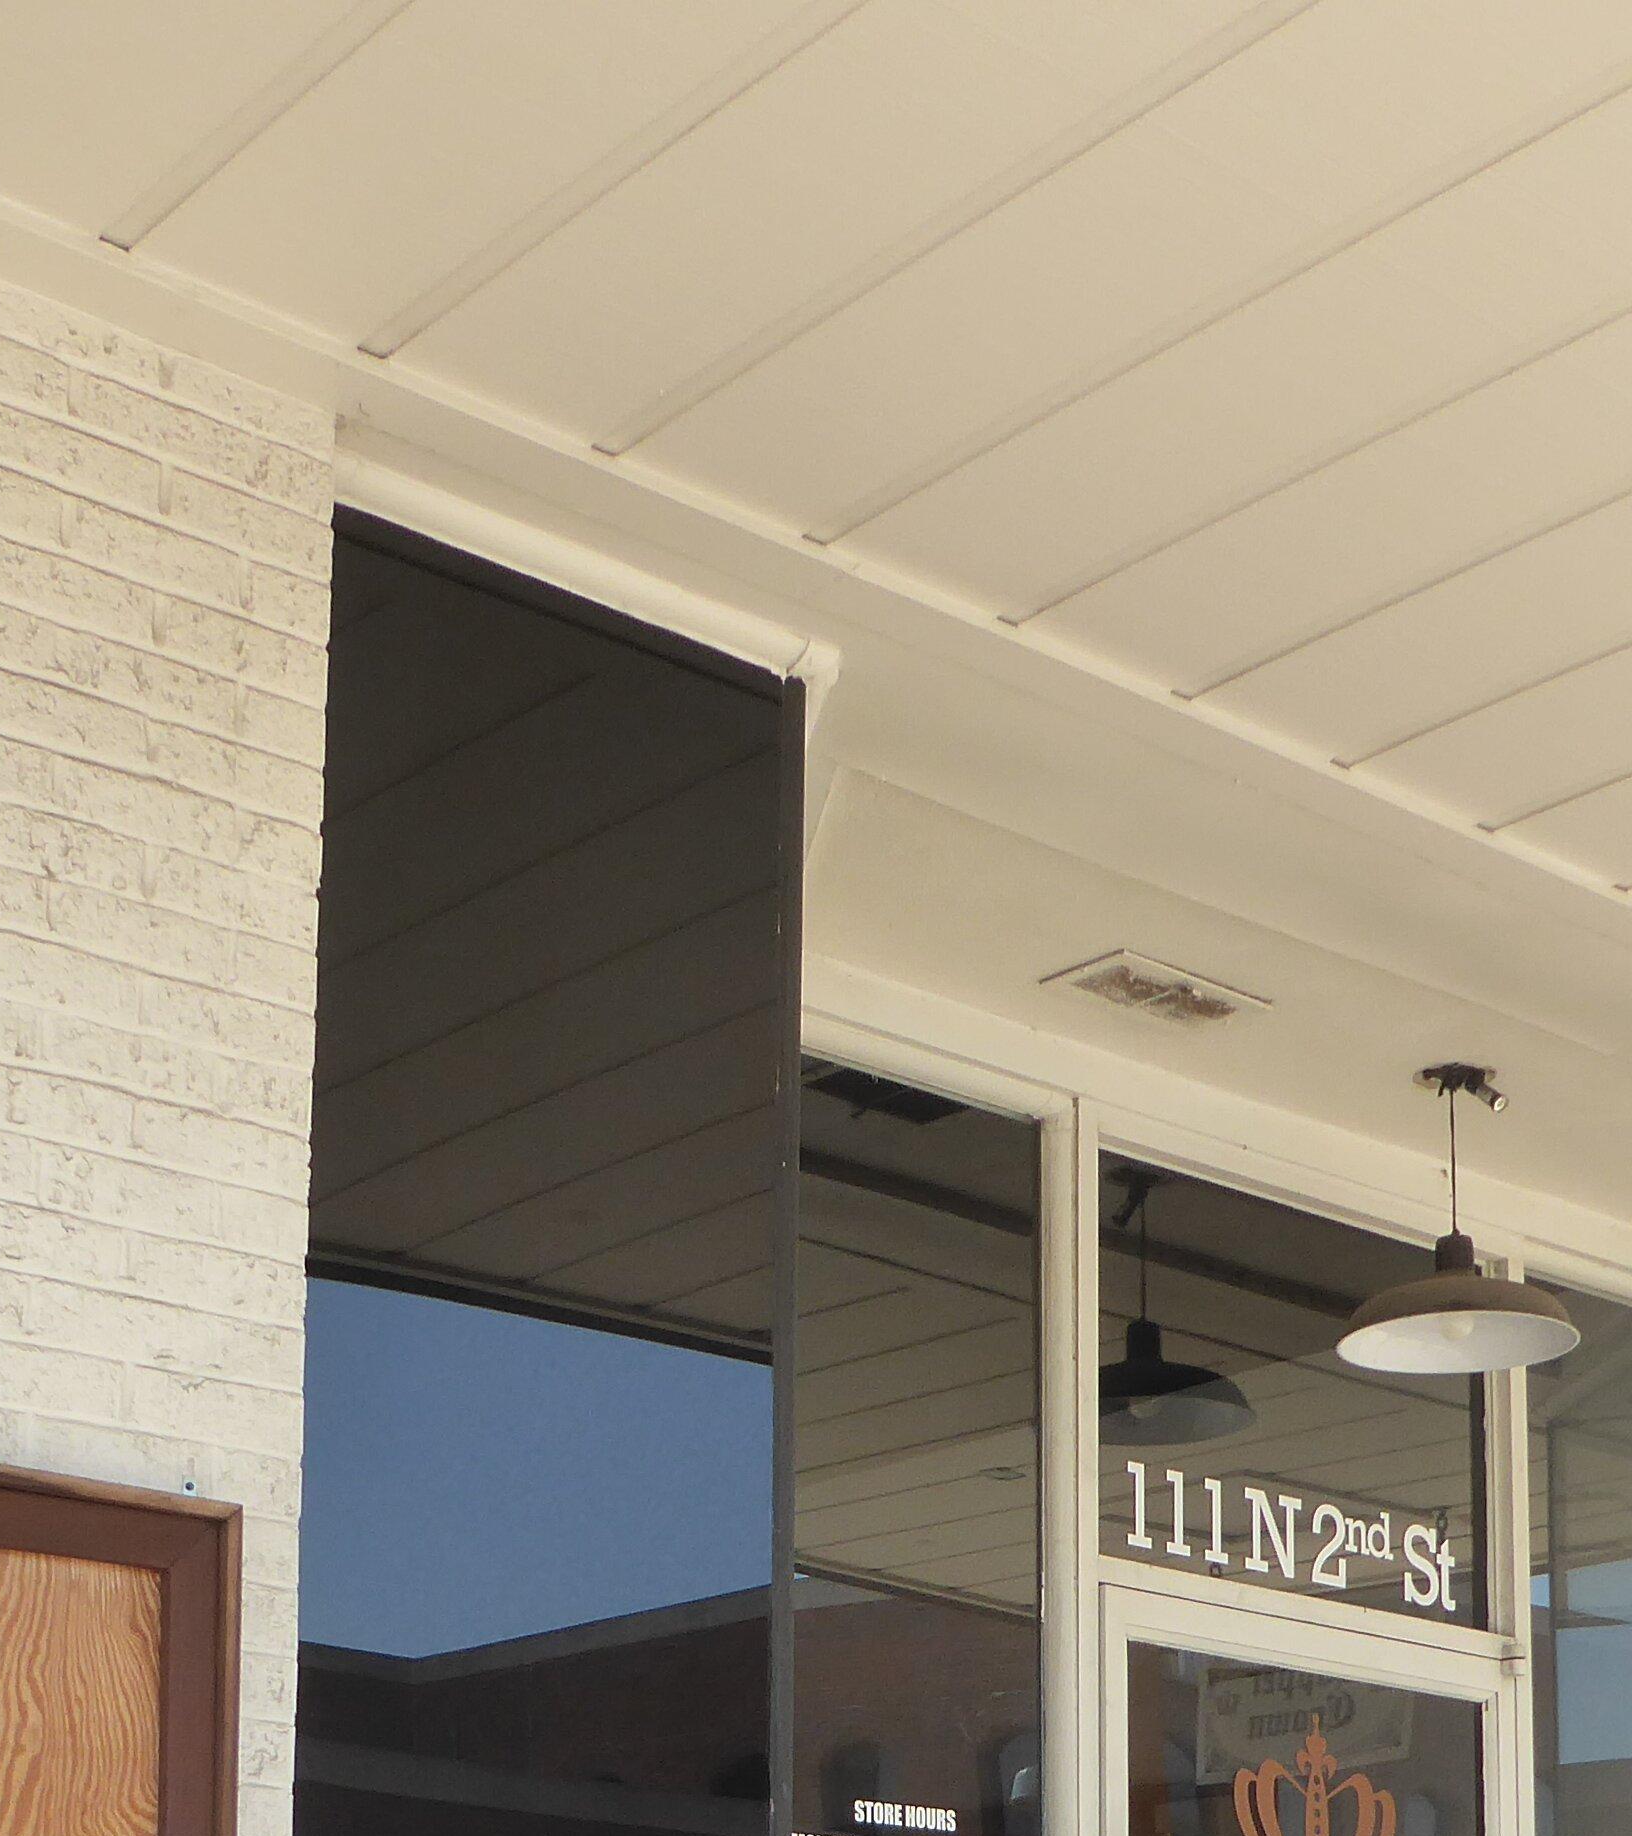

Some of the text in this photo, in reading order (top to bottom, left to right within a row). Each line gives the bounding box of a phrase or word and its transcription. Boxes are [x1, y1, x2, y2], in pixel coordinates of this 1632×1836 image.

[1126, 1460, 1458, 1613] 111 N 2nd St
[854, 1799, 957, 1832] STORE HOURS
